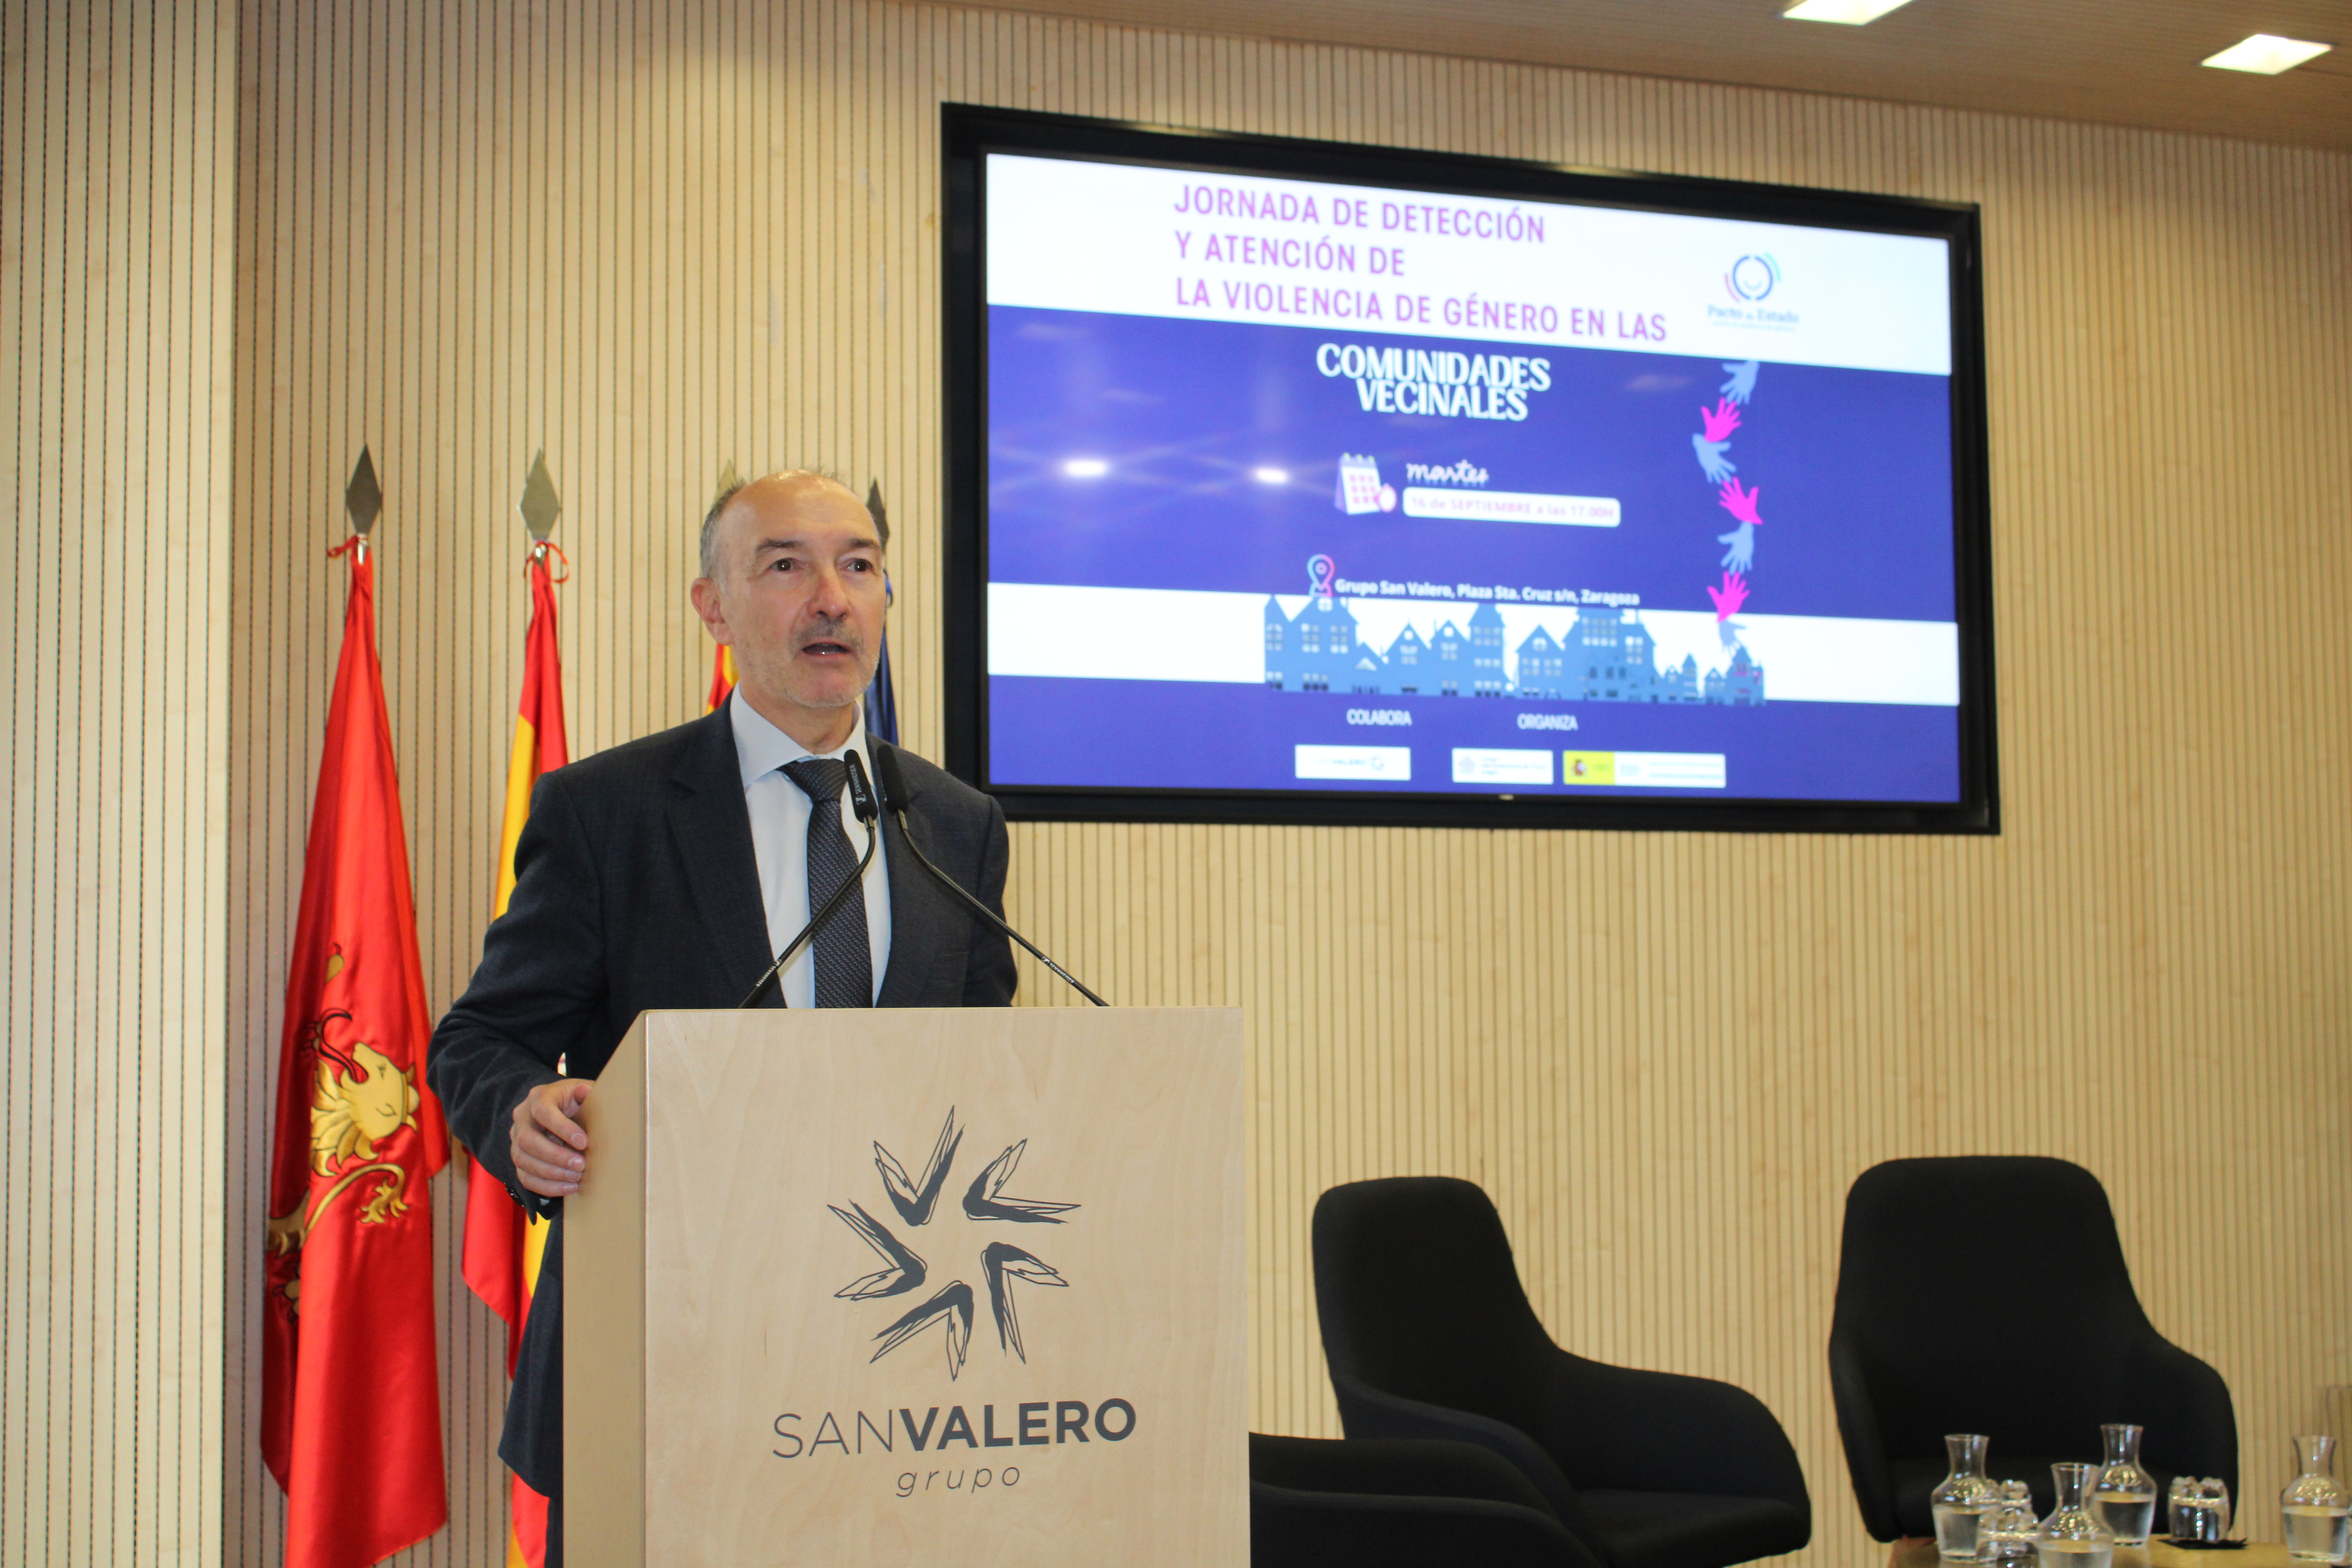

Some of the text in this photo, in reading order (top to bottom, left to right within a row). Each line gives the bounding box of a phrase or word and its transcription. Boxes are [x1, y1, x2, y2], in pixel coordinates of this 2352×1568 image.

[1174, 186, 1543, 241] JORNADA DE DETECCIÓN
[1176, 232, 1404, 276] Y ATENCIÓN DE
[1177, 278, 1666, 341] LA VIOLENCIA DE GÉNERO EN LAS
[1316, 343, 1551, 392] COMUNIDADES
[1356, 378, 1528, 421] VECINALES
[1334, 578, 1379, 598] Grupo
[1379, 580, 1407, 596] San
[1406, 581, 1456, 601] Valero,
[1456, 583, 1494, 601] Plaza
[1494, 584, 1521, 601] Sta.
[1521, 586, 1554, 603] Cruz
[1580, 589, 1642, 609] Zaragoza
[1346, 708, 1413, 726] COLABORA
[1516, 713, 1579, 731] ORGANIZA
[773, 1398, 1136, 1458] SANVALERO
[897, 1467, 1020, 1497] grupo
